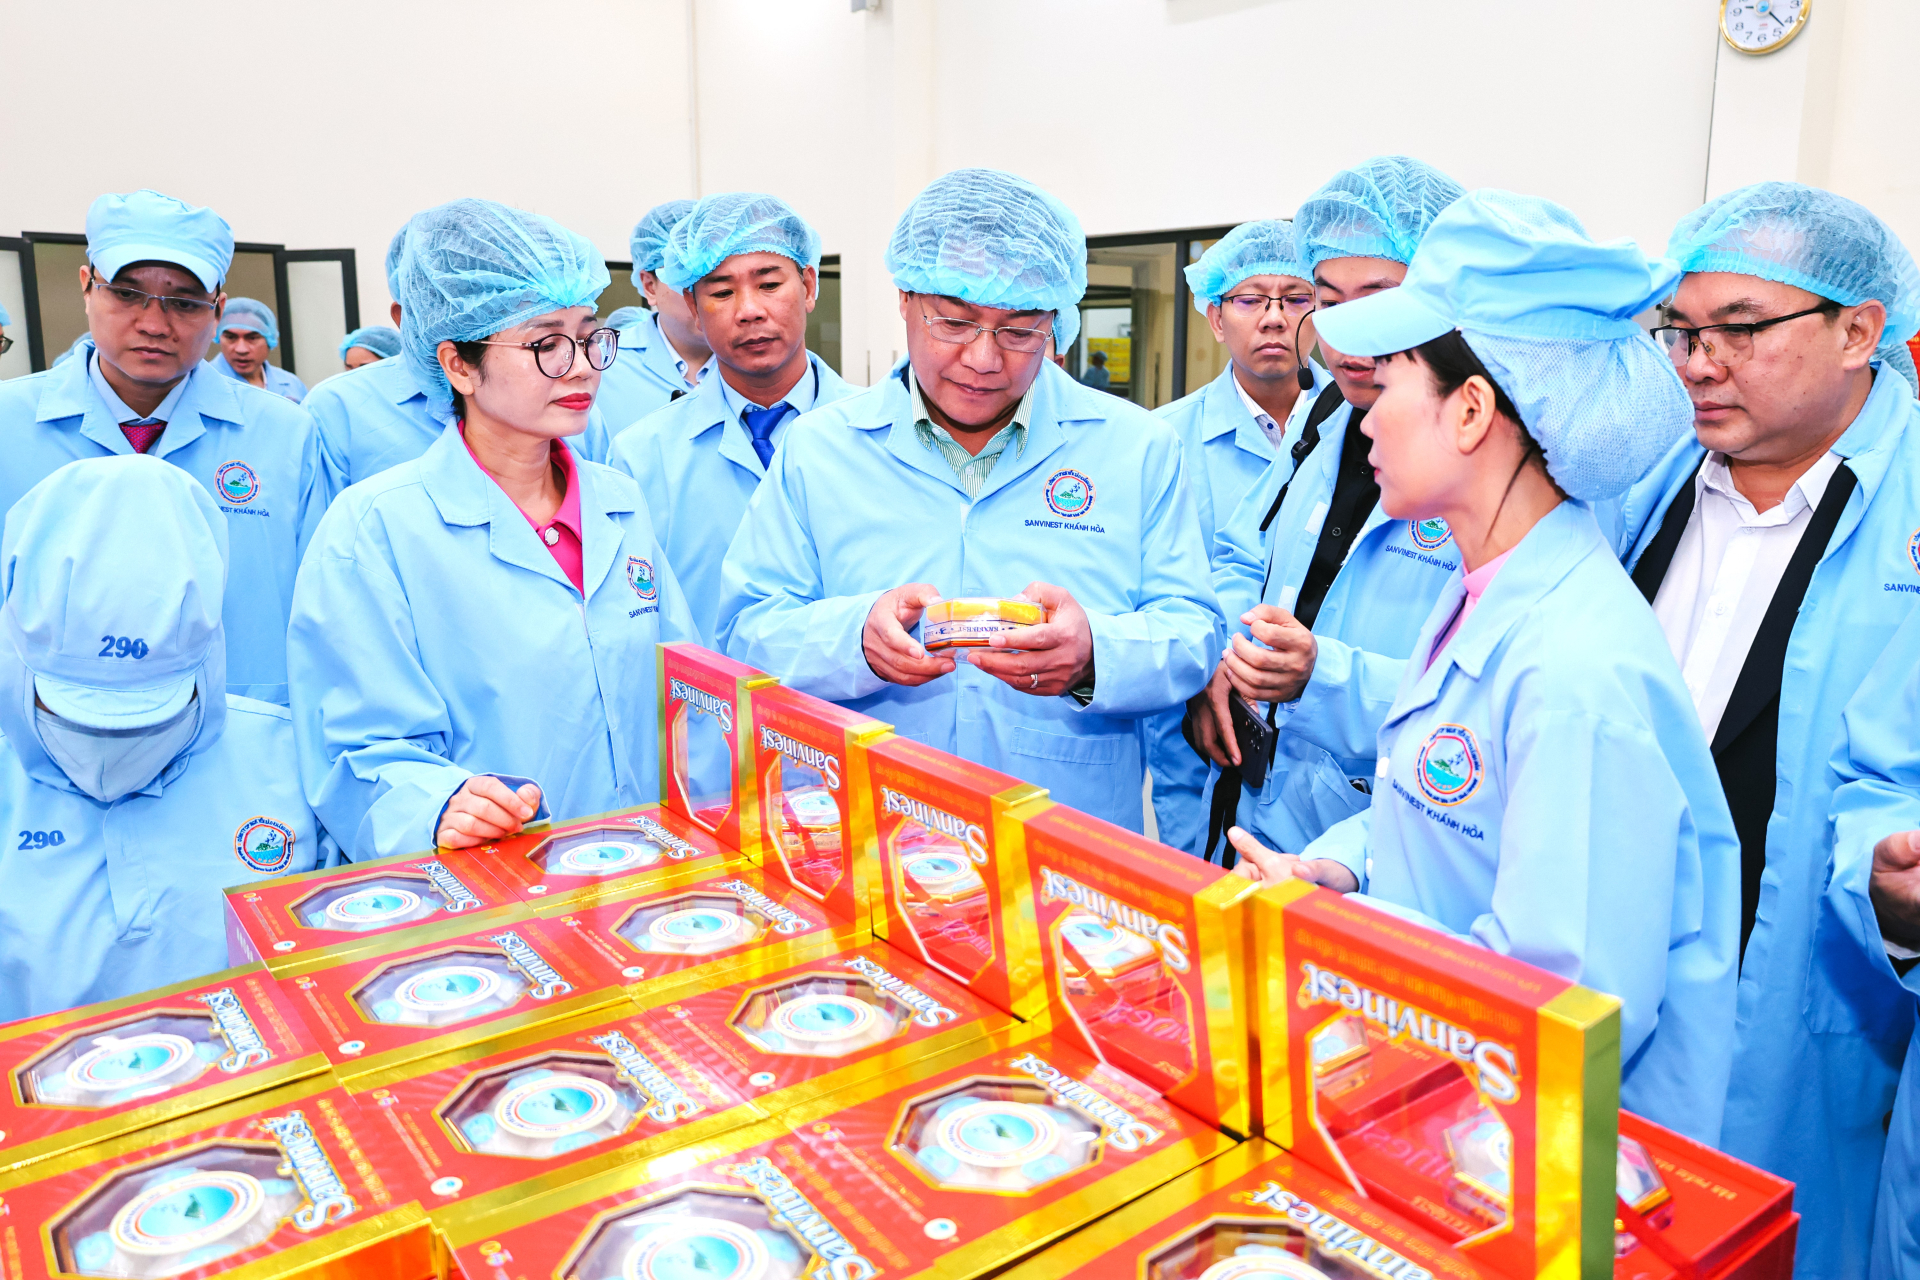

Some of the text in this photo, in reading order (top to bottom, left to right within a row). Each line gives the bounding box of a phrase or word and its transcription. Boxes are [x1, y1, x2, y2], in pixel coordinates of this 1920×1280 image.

[1732, 8, 1742, 17] 9
[1735, 22, 1744, 31] 8
[1745, 31, 1753, 40] 7
[1757, 33, 1767, 43] 6
[1772, 27, 1782, 37] 5
[1784, 15, 1793, 24] 4
[1024, 519, 1106, 534] SANVINEST KHÁNH HÒA
[1385, 545, 1418, 560] SANVINEST
[1417, 554, 1441, 567] KHÁNH
[1883, 583, 1920, 595] SANVINE
[98, 635, 149, 660] 290
[669, 678, 733, 733] Sanvinest
[760, 726, 841, 790] Sanvinest
[18, 830, 66, 851] 290
[628, 815, 702, 860] Sanvinest
[881, 786, 989, 864] Sanvinest
[1426, 807, 1460, 831] KHÁNH
[1461, 824, 1484, 841] HÒA
[419, 860, 483, 912] Sanvinest
[718, 878, 816, 934] Sanvinest
[1041, 866, 1190, 973] Sanvinest
[491, 931, 574, 1000] Sanvinest
[843, 955, 958, 1027] Sanvinest
[202, 987, 274, 1073] Sanvinest
[1303, 961, 1520, 1101] Sanvinest
[591, 1030, 703, 1123] Sanvinest
[1010, 1052, 1163, 1153] Sanvinest
[265, 1109, 357, 1230] Sanvinest
[1253, 1180, 1432, 1280] anvinest
